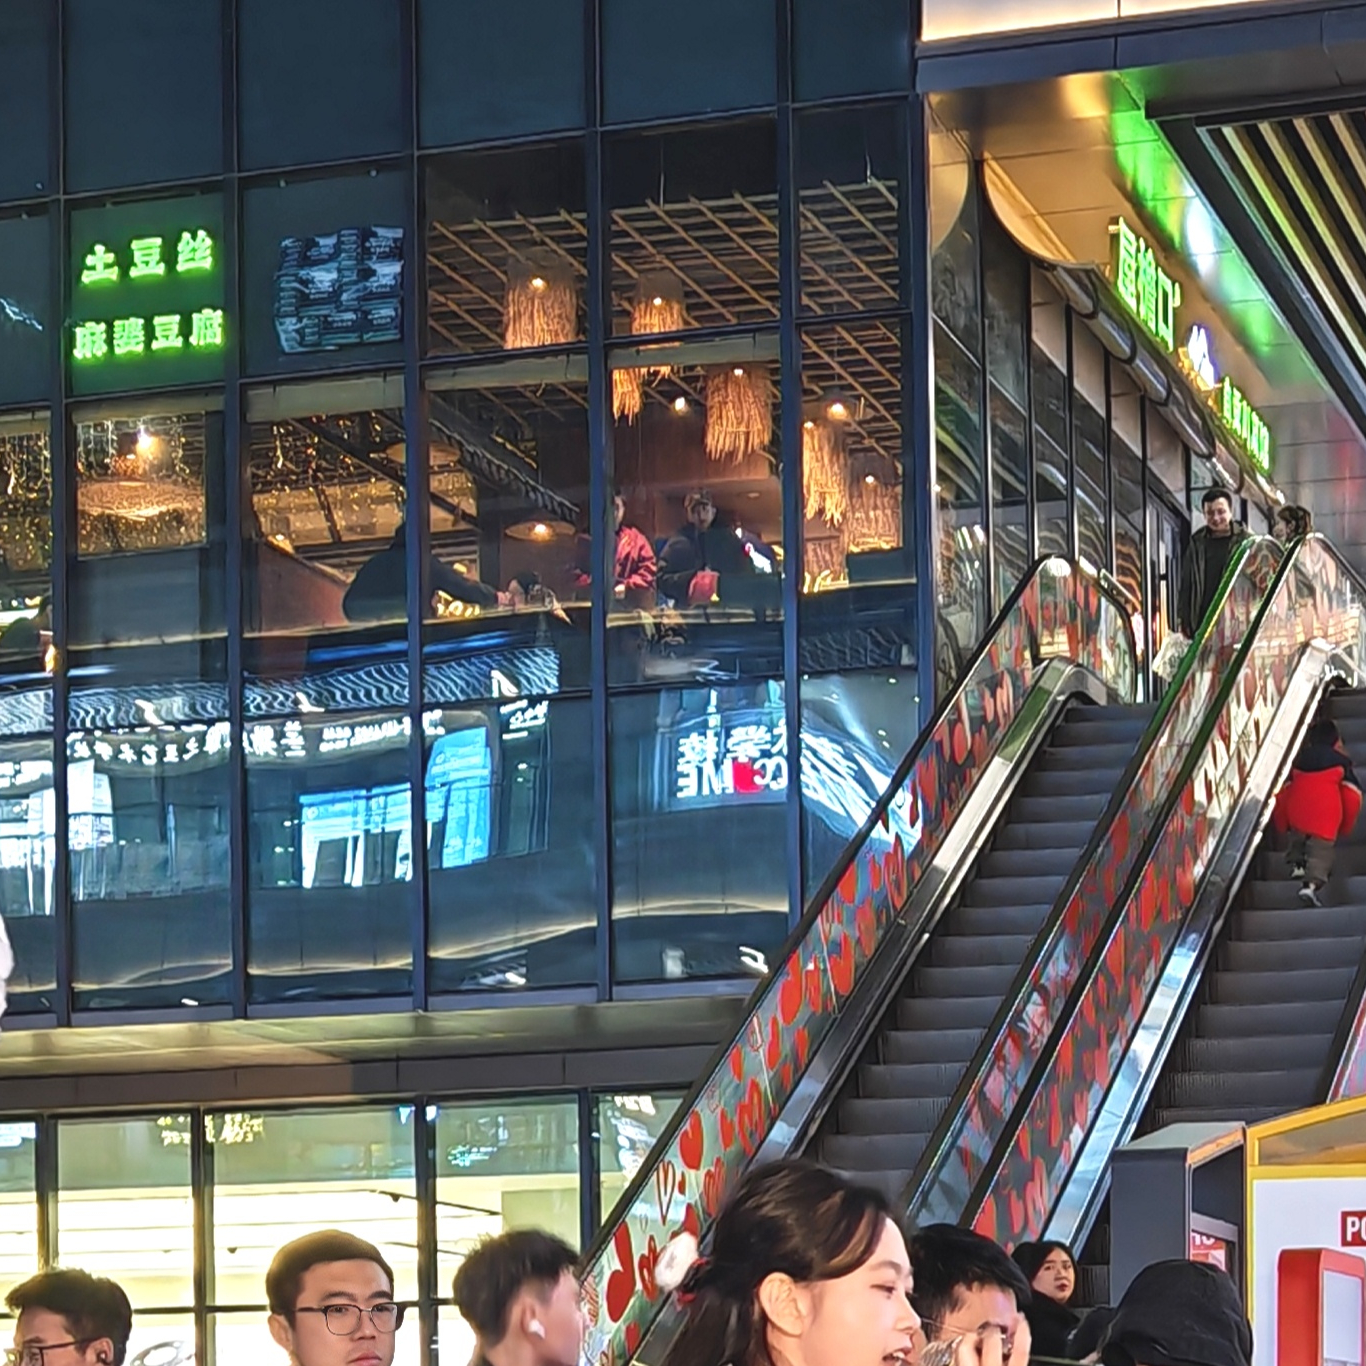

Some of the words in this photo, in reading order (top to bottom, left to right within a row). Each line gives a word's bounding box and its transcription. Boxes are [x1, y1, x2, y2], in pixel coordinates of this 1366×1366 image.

[80, 229, 214, 286] 土豆丝
[73, 308, 225, 360] 麻婆豆腐
